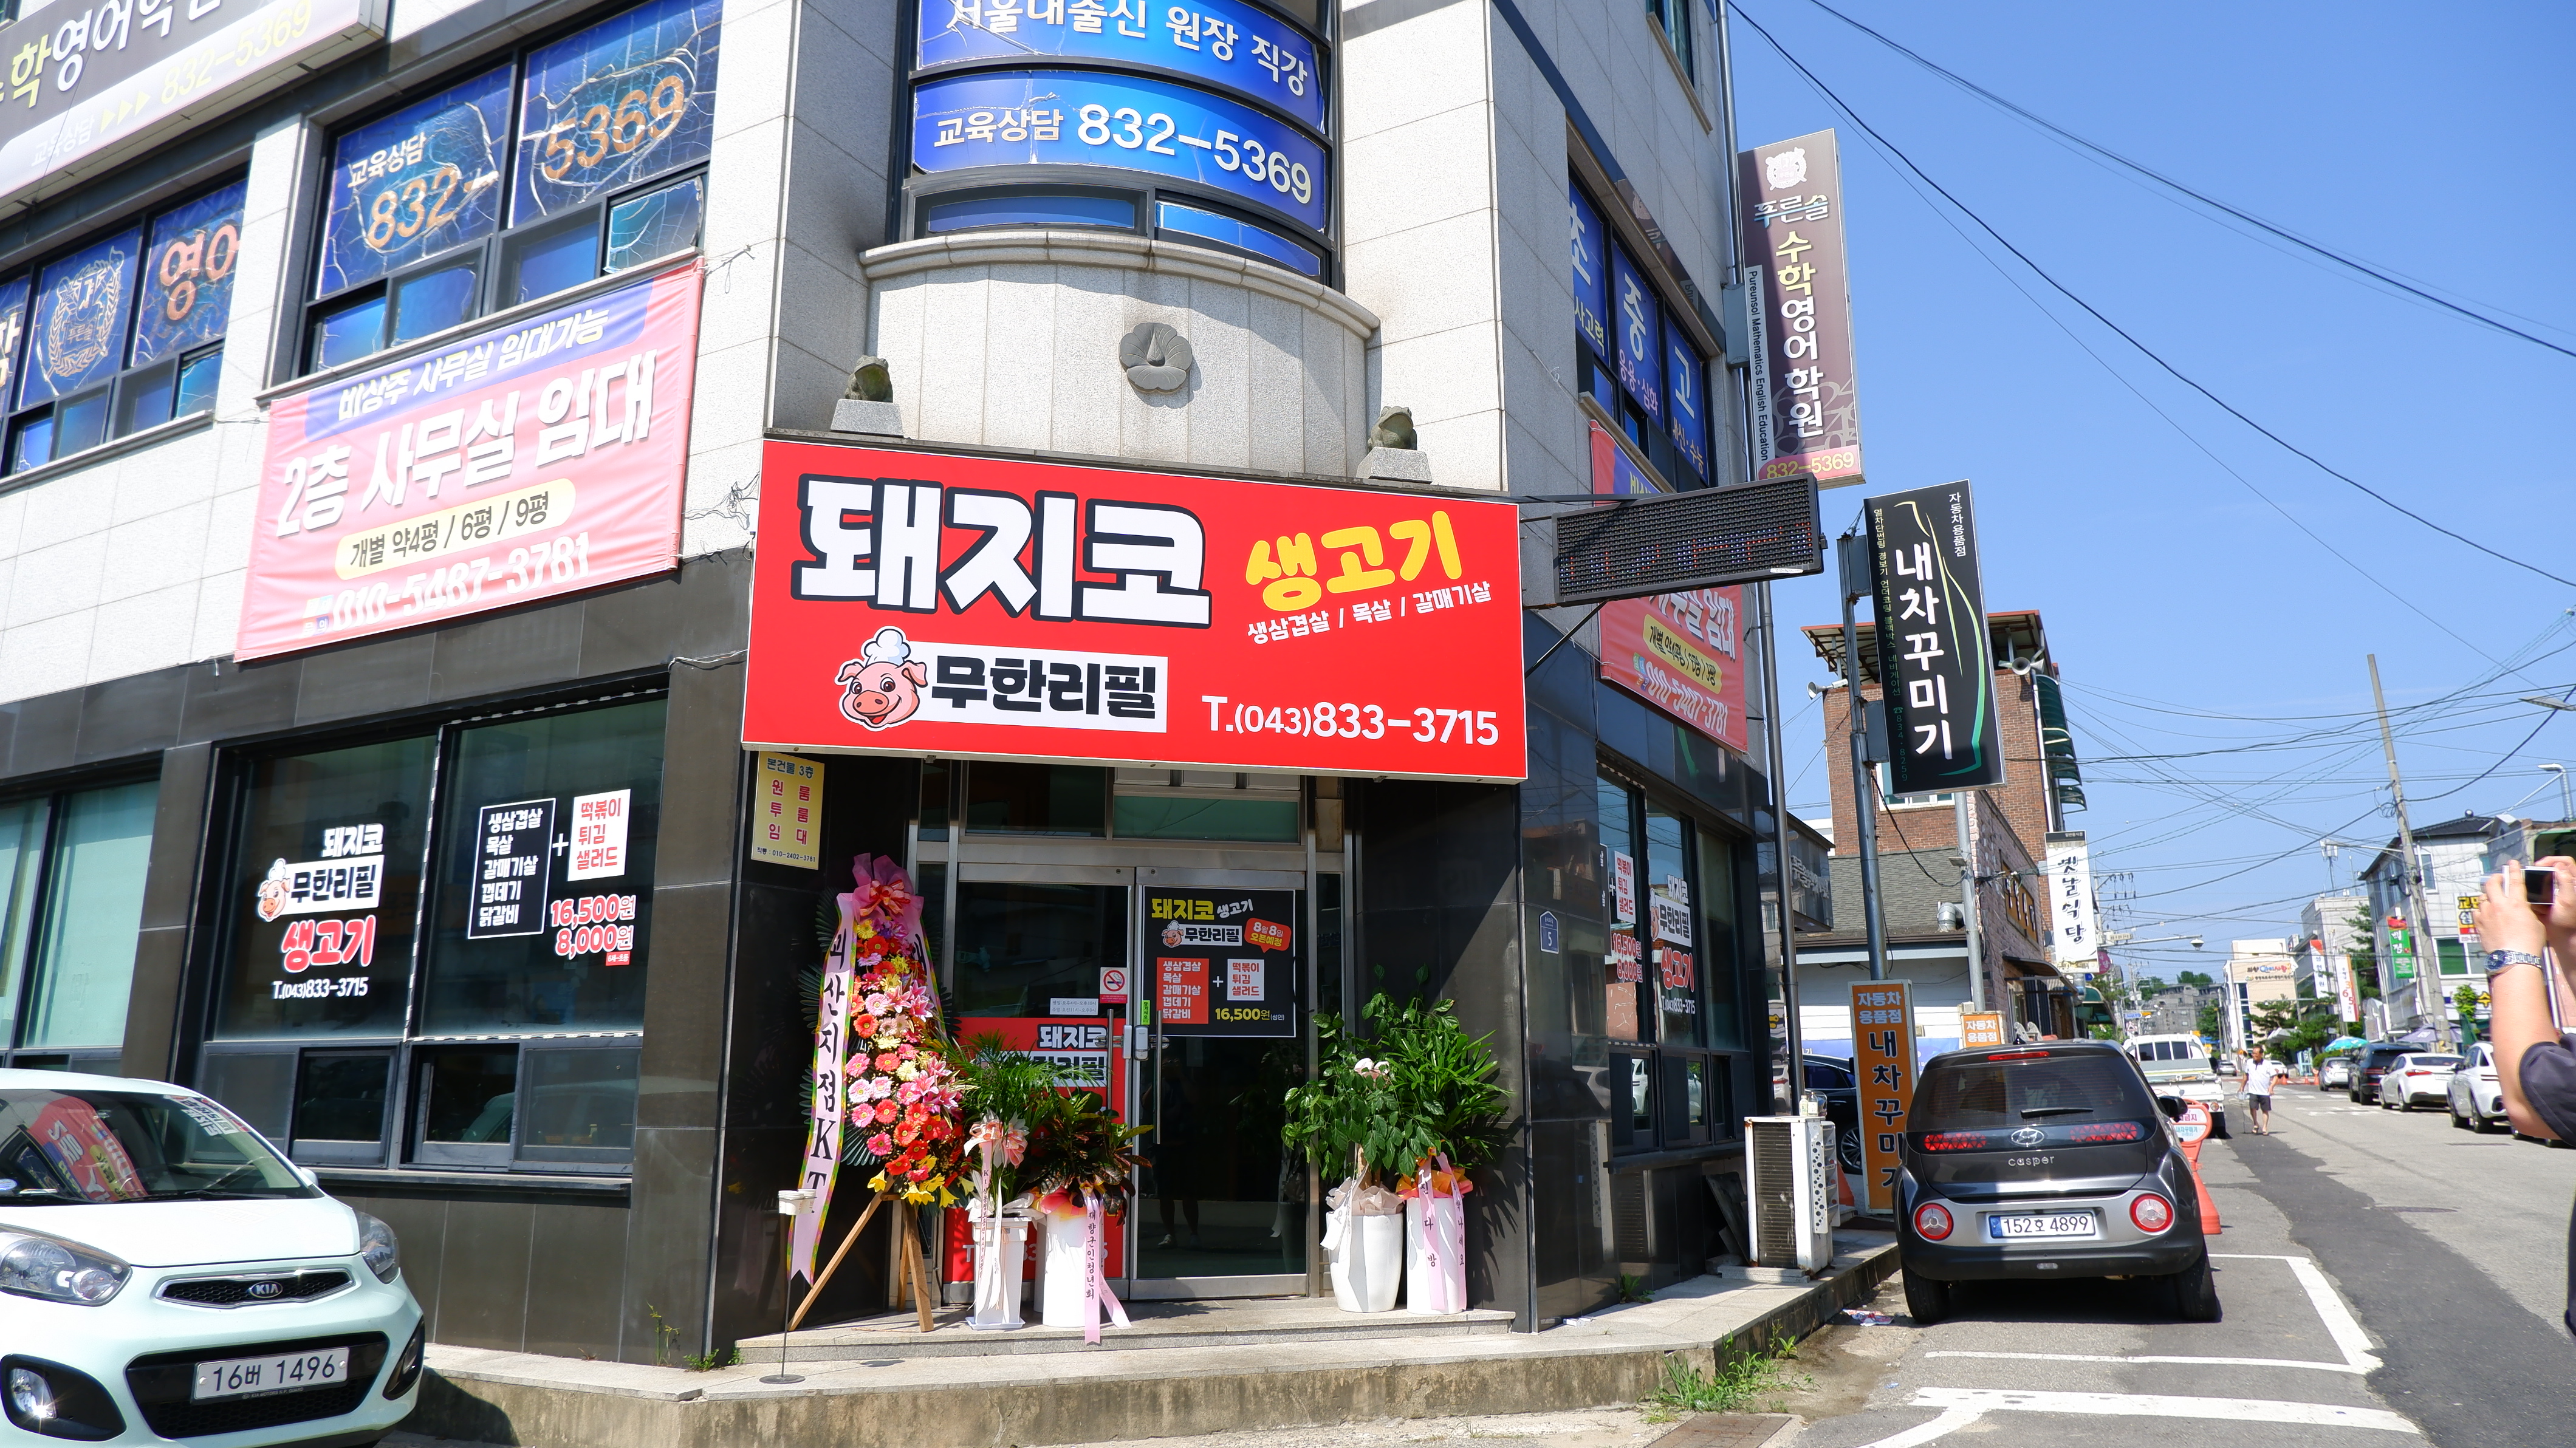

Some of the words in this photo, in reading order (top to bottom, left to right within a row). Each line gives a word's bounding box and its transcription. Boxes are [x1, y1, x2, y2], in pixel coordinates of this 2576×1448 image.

[159, 4, 313, 107] 832-5369
[1166, 6, 1239, 61] 원장
[1252, 35, 1309, 97] 직강
[347, 132, 427, 190] 교육상담
[934, 108, 1064, 148] 교육상담
[1077, 103, 1312, 205] 832-5369
[1754, 194, 1829, 228] 푸른솔
[1749, 270, 1761, 315] Pureunsol
[1624, 271, 1647, 361] 중
[1752, 318, 1762, 375] Mathematics
[338, 367, 412, 422] 비상주
[413, 340, 495, 396] 사무실
[496, 307, 611, 372] 임대가능
[1675, 345, 1695, 419] 고
[1756, 378, 1767, 412] English
[275, 443, 353, 539] 2층
[359, 389, 521, 511] 사무실
[535, 347, 658, 469] 임대
[1758, 414, 1769, 462] Education
[1766, 452, 1854, 479] 832-5369
[349, 532, 388, 569] 개별
[391, 517, 440, 558] 약4평
[461, 503, 494, 542] 6평
[515, 490, 550, 527] 9평
[1874, 508, 1886, 549] 열차단썬팅
[1948, 492, 1967, 558] 자동차용품점
[791, 472, 1212, 629] 돼지코
[1245, 511, 1462, 612] 생고기
[1878, 552, 1889, 576] 경보기
[332, 530, 591, 632] 010-5487-3781
[1247, 609, 1331, 645] 생삼겹살
[1352, 598, 1393, 624] 목살
[1412, 581, 1492, 615] 갈매기살
[1895, 542, 1953, 760] 내차꾸미기
[931, 654, 1156, 720] 무한리필
[1887, 654, 1902, 697] 네비게이션
[1645, 660, 1729, 737] 010-5487-3781
[1201, 694, 1499, 746] T.(043)833-3715
[767, 757, 796, 775] 본건물
[799, 765, 814, 779] 3층
[488, 807, 544, 834] 생삼겹살
[581, 797, 622, 821] 떡볶이
[321, 822, 385, 859] 돼지코
[486, 834, 513, 856] 목살
[578, 824, 606, 845] 튀김
[483, 855, 539, 881] 갈매기살
[577, 846, 618, 870] 샐러드
[772, 850, 816, 863] 010-2402-3781
[290, 863, 378, 904] 무한리필
[481, 880, 522, 904] 껍데기
[1666, 873, 1690, 904] 돼지코
[551, 893, 637, 930] 16,500원
[1151, 898, 1215, 921] 돼지코
[1217, 898, 1254, 919] 생고기
[1619, 896, 1634, 916] 샐러드
[2057, 855, 2087, 944] 옛날식당
[479, 904, 520, 927] 닭갈비
[1659, 903, 1691, 940] 무한리필
[555, 923, 634, 960] 8,000원
[1184, 927, 1240, 943] 무한리필
[1250, 933, 1283, 948] 오픈예정
[1253, 921, 1269, 934] 8월
[1269, 923, 1284, 938] 8일
[1547, 931, 1552, 947] 5
[281, 914, 377, 974] 생고기
[1162, 961, 1202, 973] 생삼겹살
[1162, 973, 1182, 984] 목살
[1231, 962, 1261, 974] 떡볶이
[1231, 974, 1252, 985] 튀김
[1617, 957, 1643, 983] 8,000원
[1660, 946, 1695, 992] 생고기
[1162, 985, 1202, 996] 갈매기살
[1162, 997, 1192, 1008] 껍데기
[1231, 985, 1261, 997] 샐러드
[1857, 991, 1902, 1006] 자동차
[1162, 1008, 1191, 1020] 닭갈비
[1214, 1008, 1270, 1023] 16,500원
[1858, 1008, 1903, 1025] 용품점
[1965, 1019, 1997, 1031] 자동차
[1038, 1025, 1107, 1049] 돼지코
[1967, 1031, 1998, 1043] 용품점
[2008, 1155, 2055, 1168] casper
[2003, 1217, 2046, 1235] 152호
[2050, 1217, 2089, 1232] 4899
[255, 1284, 279, 1296] KIA
[276, 1354, 335, 1384] 1496
